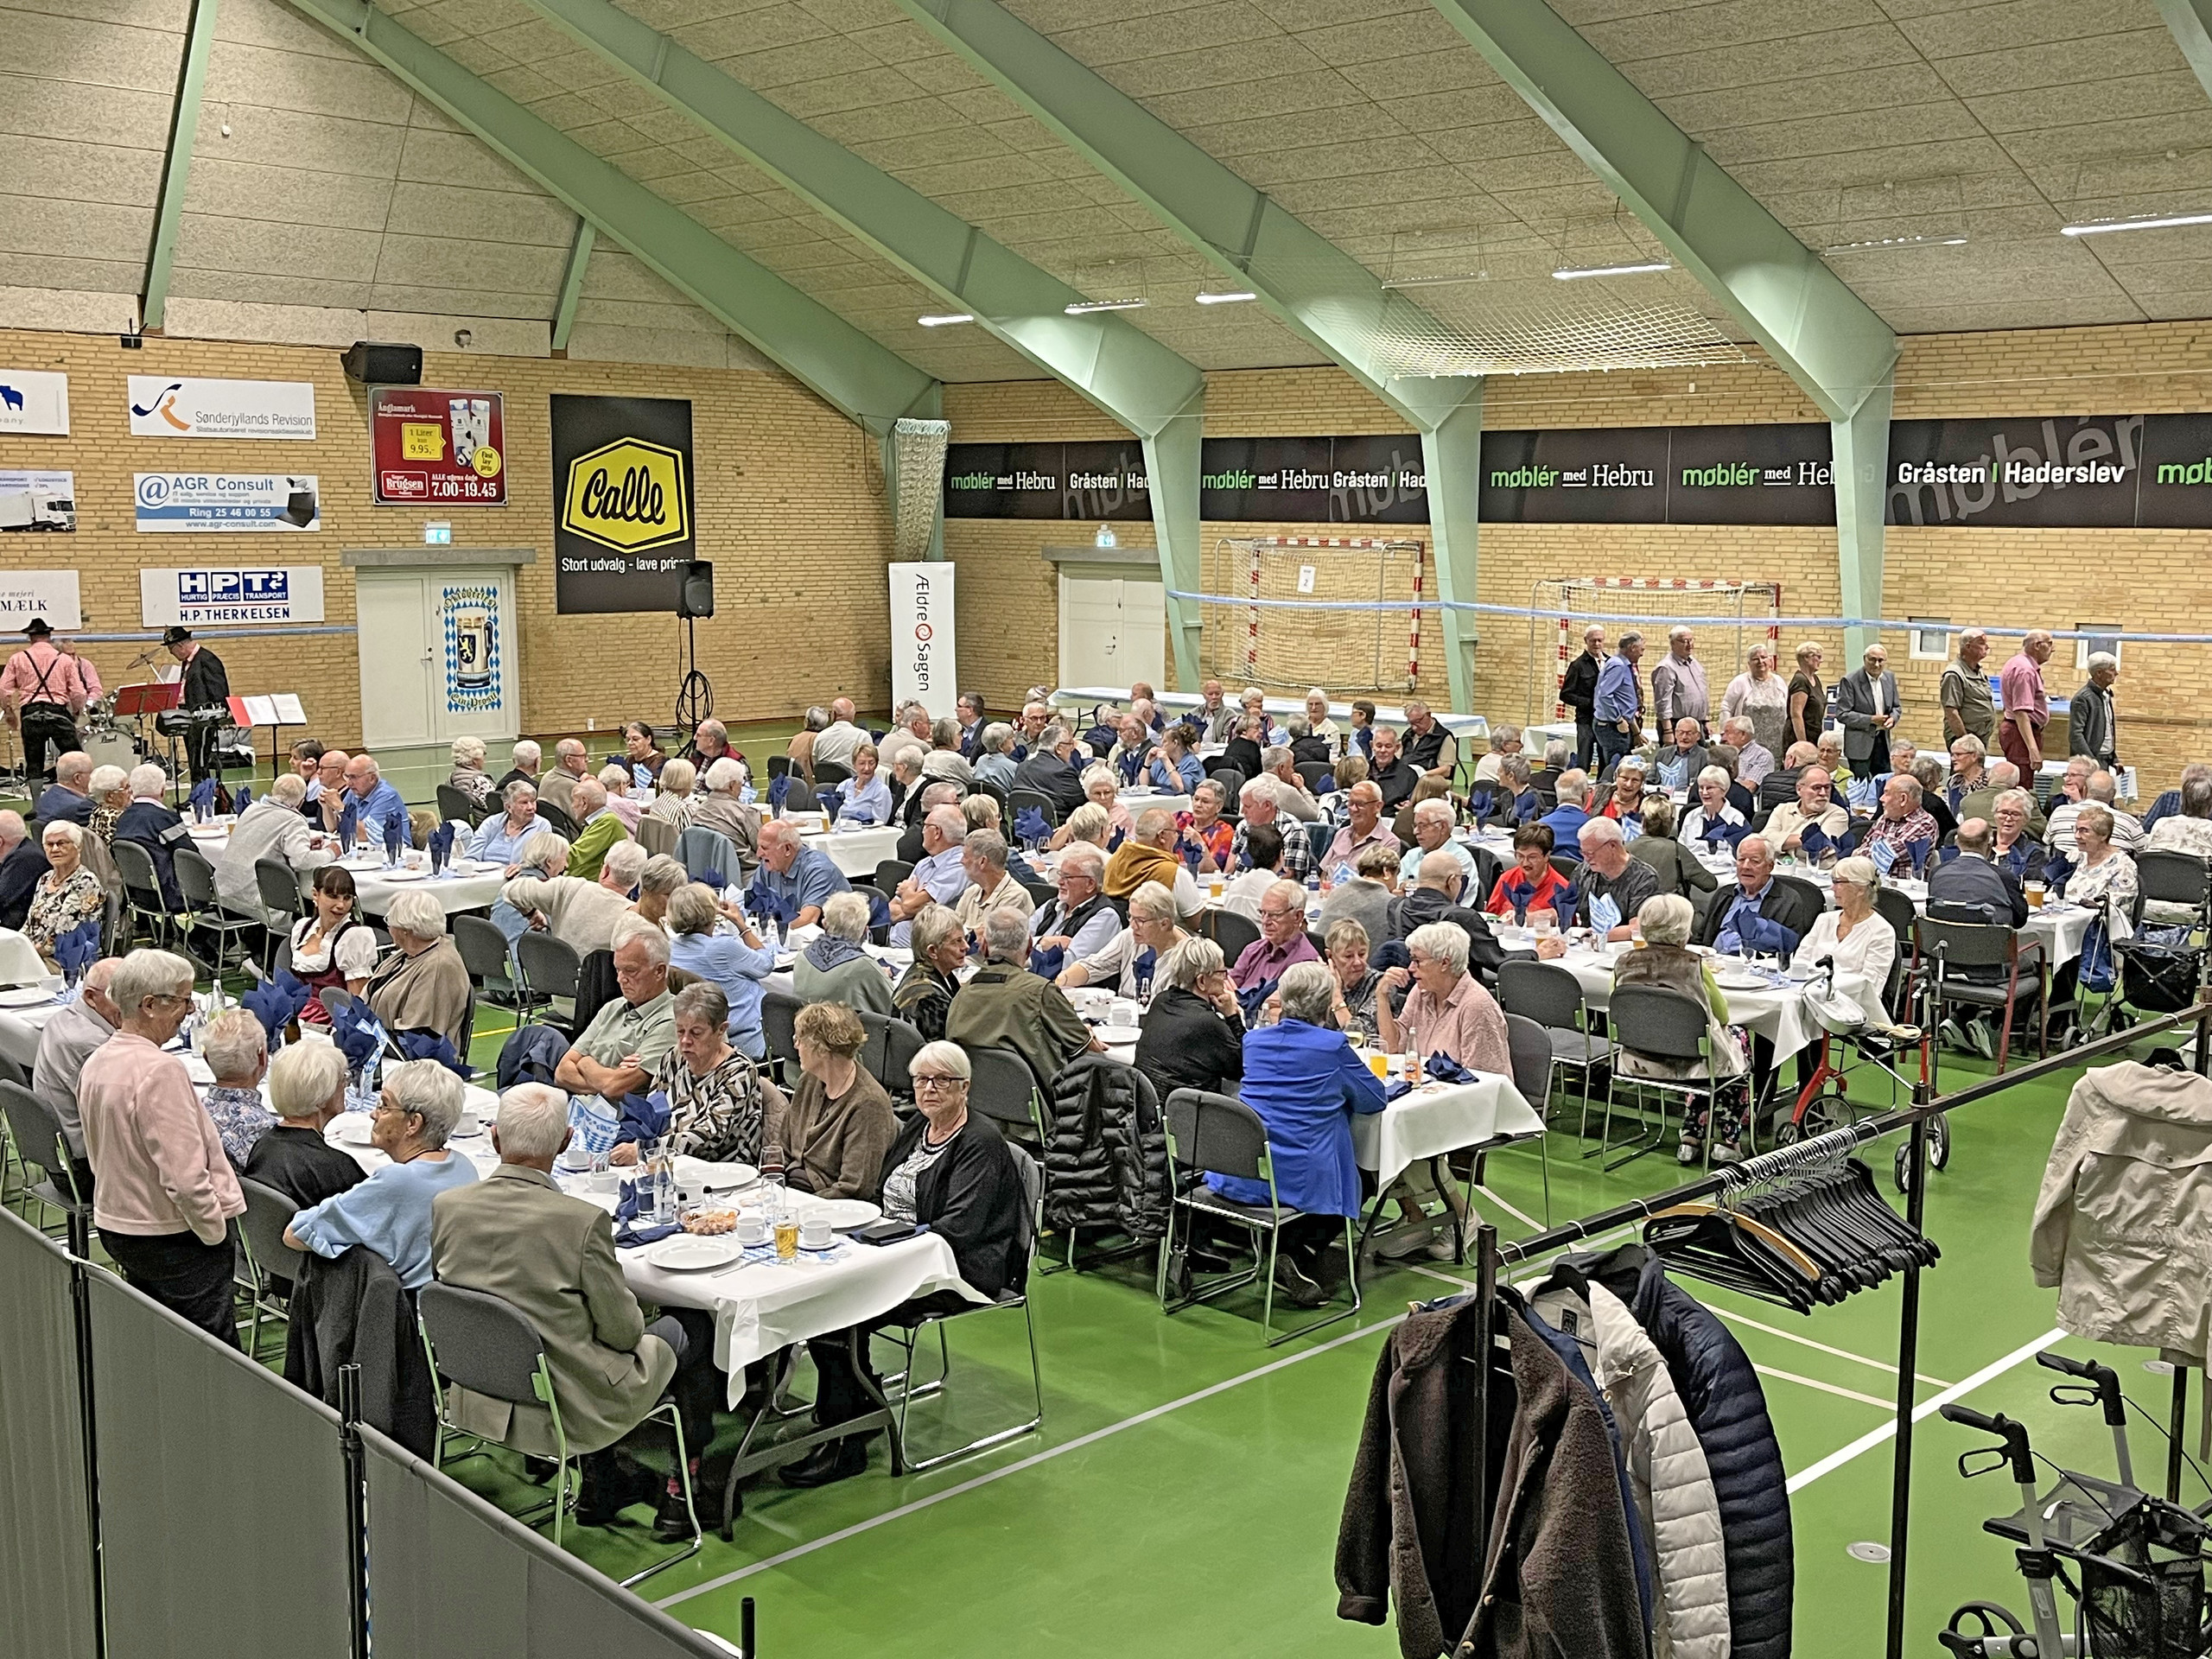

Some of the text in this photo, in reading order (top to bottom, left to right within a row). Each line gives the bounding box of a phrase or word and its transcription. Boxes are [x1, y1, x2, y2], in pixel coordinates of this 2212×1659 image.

[195, 410, 313, 427] Sønderjyllands Revision
[950, 471, 1056, 490] møblér med Hebru
[1070, 472, 1117, 489] Gråsten
[1202, 468, 1329, 490] møblér med Hebru
[1333, 470, 1389, 488] Gråsten
[1491, 463, 1654, 488] møblér med Hebru
[1681, 461, 1760, 487] møblér
[1764, 466, 1791, 480] med
[1897, 460, 2126, 484] Gråsten Haderslev
[173, 477, 273, 492] AGR Consult
[386, 477, 424, 492] Brugsen
[431, 482, 497, 498] 7.00-19.45
[582, 465, 665, 525] Calle
[189, 508, 212, 518] Ring
[230, 508, 242, 517] 46
[245, 508, 257, 517] 00
[260, 508, 271, 517] 55
[185, 520, 276, 529] www.agr-consult.com
[562, 557, 588, 572] Stort
[590, 557, 626, 574] udvalg
[636, 557, 658, 571] lave
[660, 556, 690, 573] pri
[181, 593, 208, 601] HURTIG
[443, 588, 498, 609] Oktoberfest
[180, 607, 289, 621] H.P. THERKELSEN
[913, 574, 931, 691] Ældre Sagen
